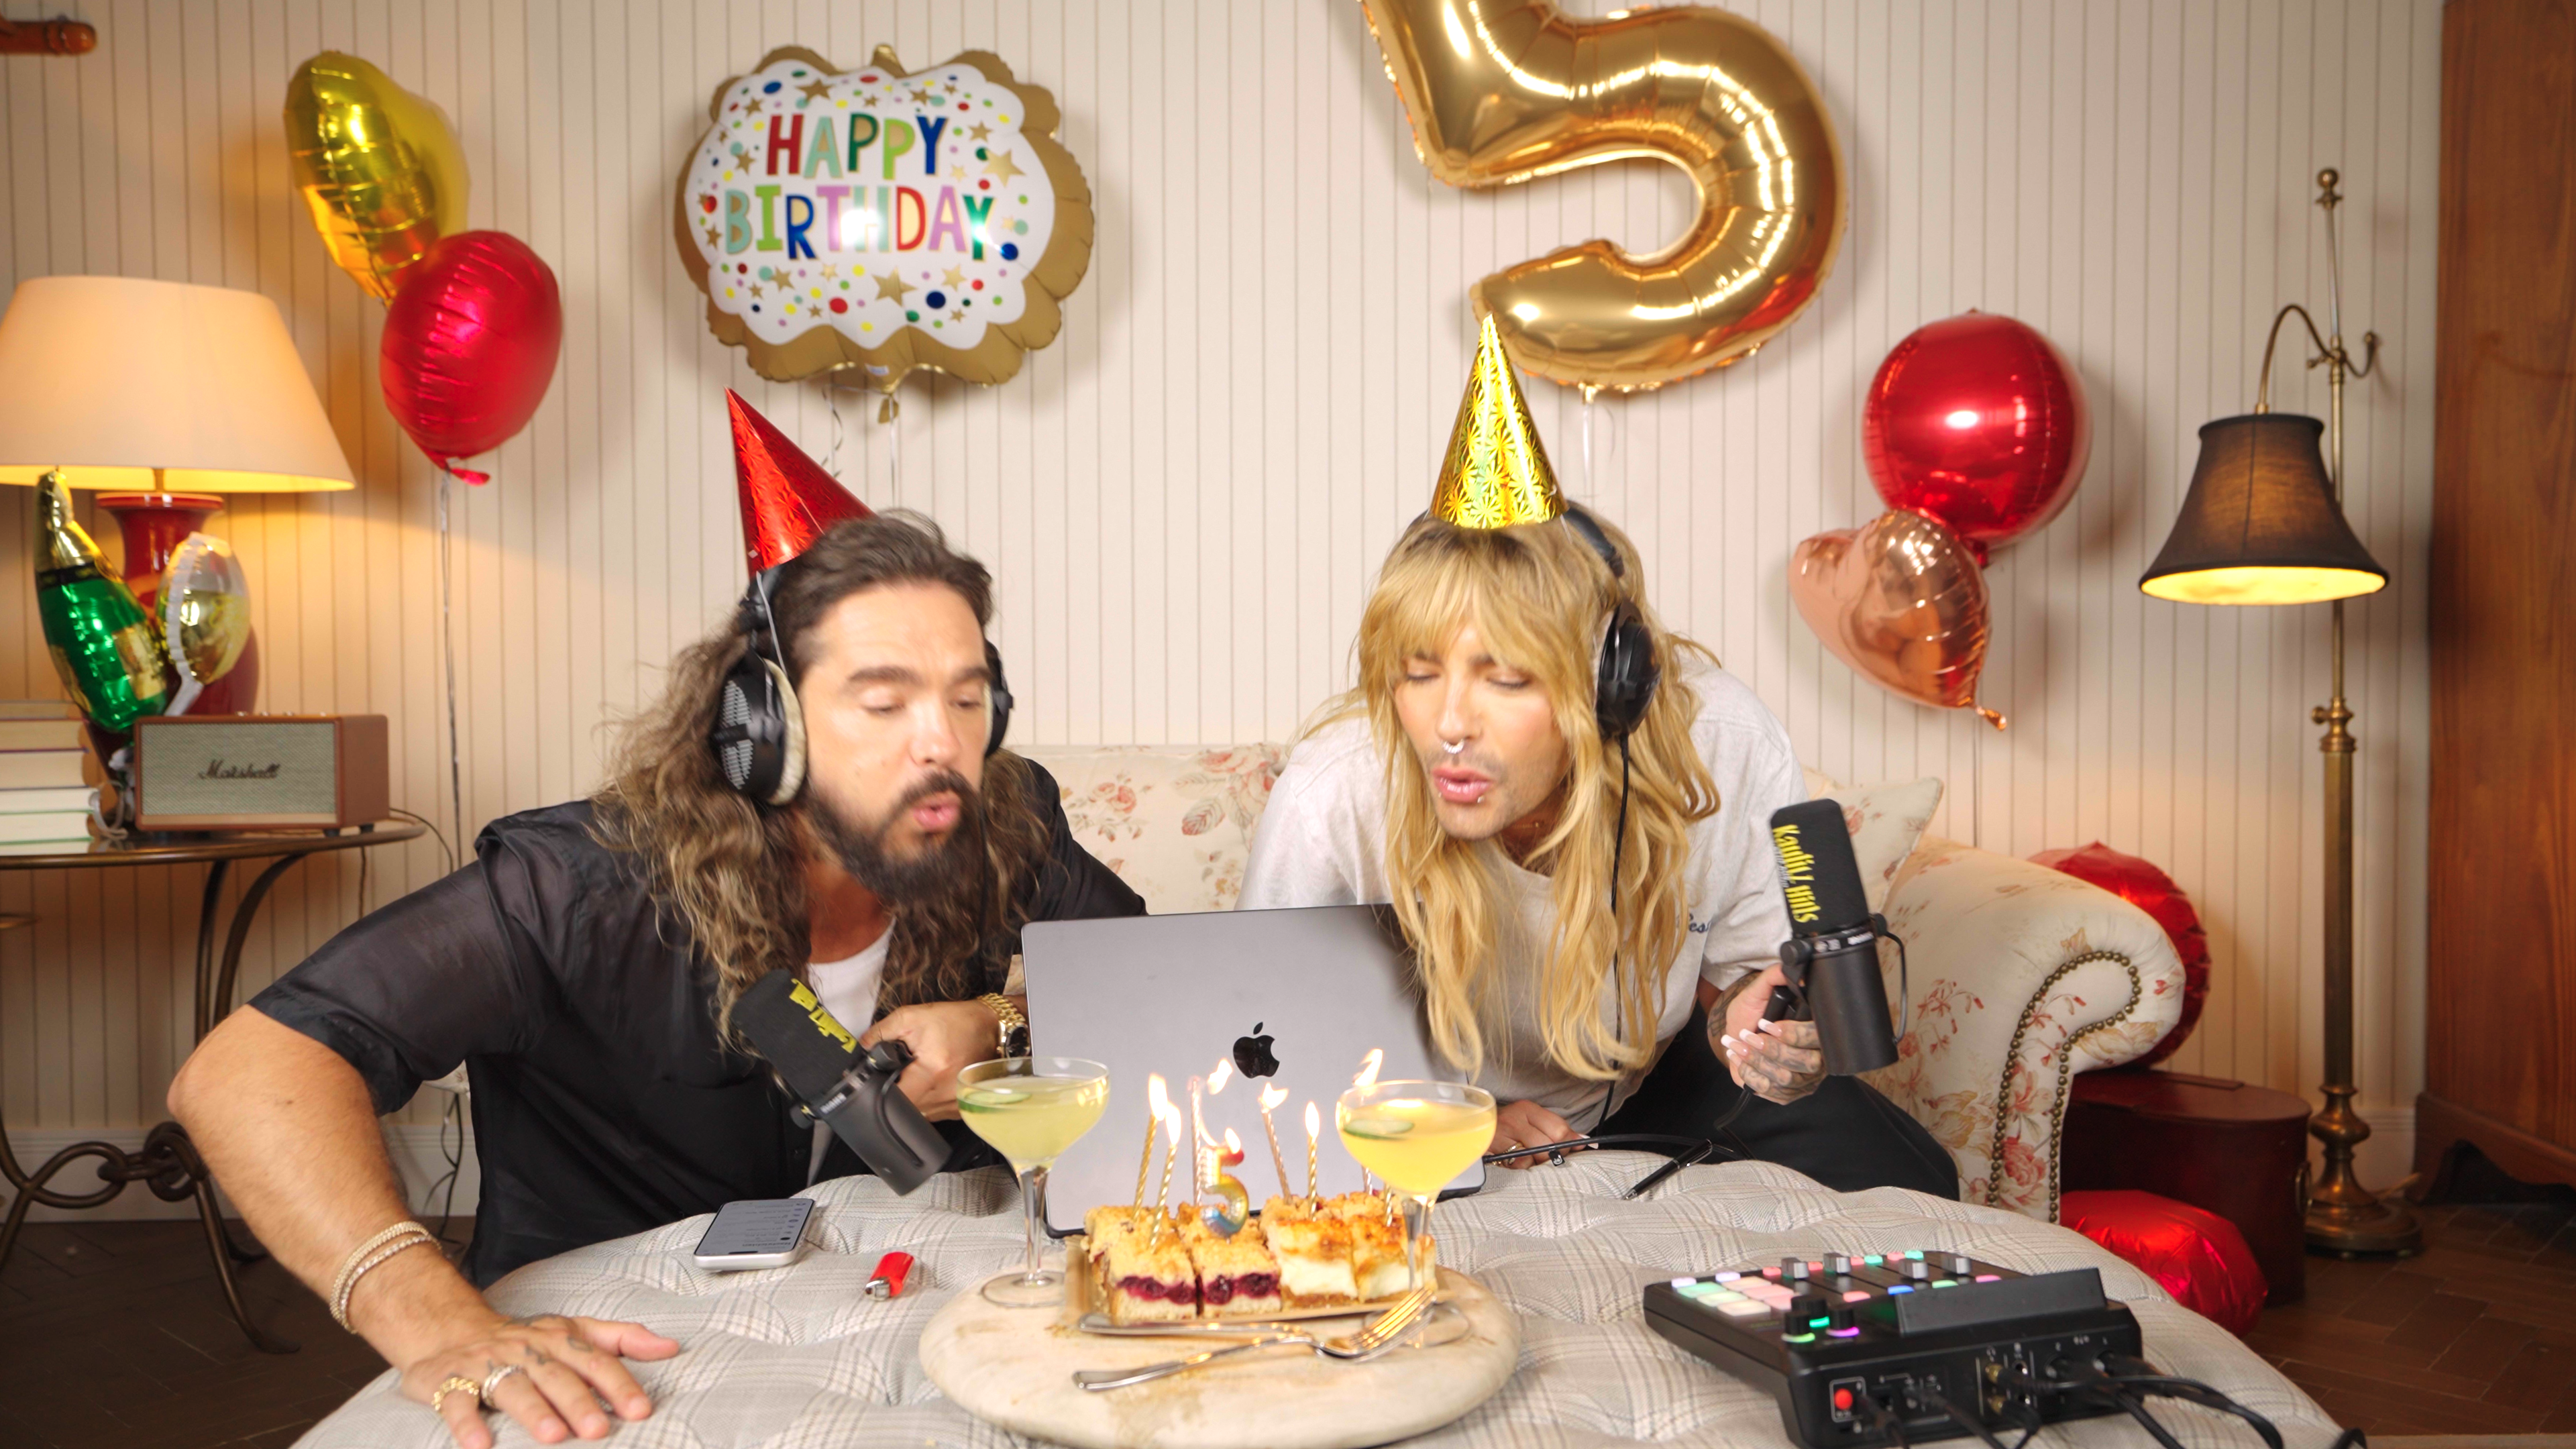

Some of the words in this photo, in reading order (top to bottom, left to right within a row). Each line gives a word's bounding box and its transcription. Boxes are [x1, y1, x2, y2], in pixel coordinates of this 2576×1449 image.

[766, 112, 949, 180] HAPPY
[724, 184, 995, 261] BIRTHDAY
[197, 759, 281, 780] Marshall
[1784, 885, 1821, 923] Hills
